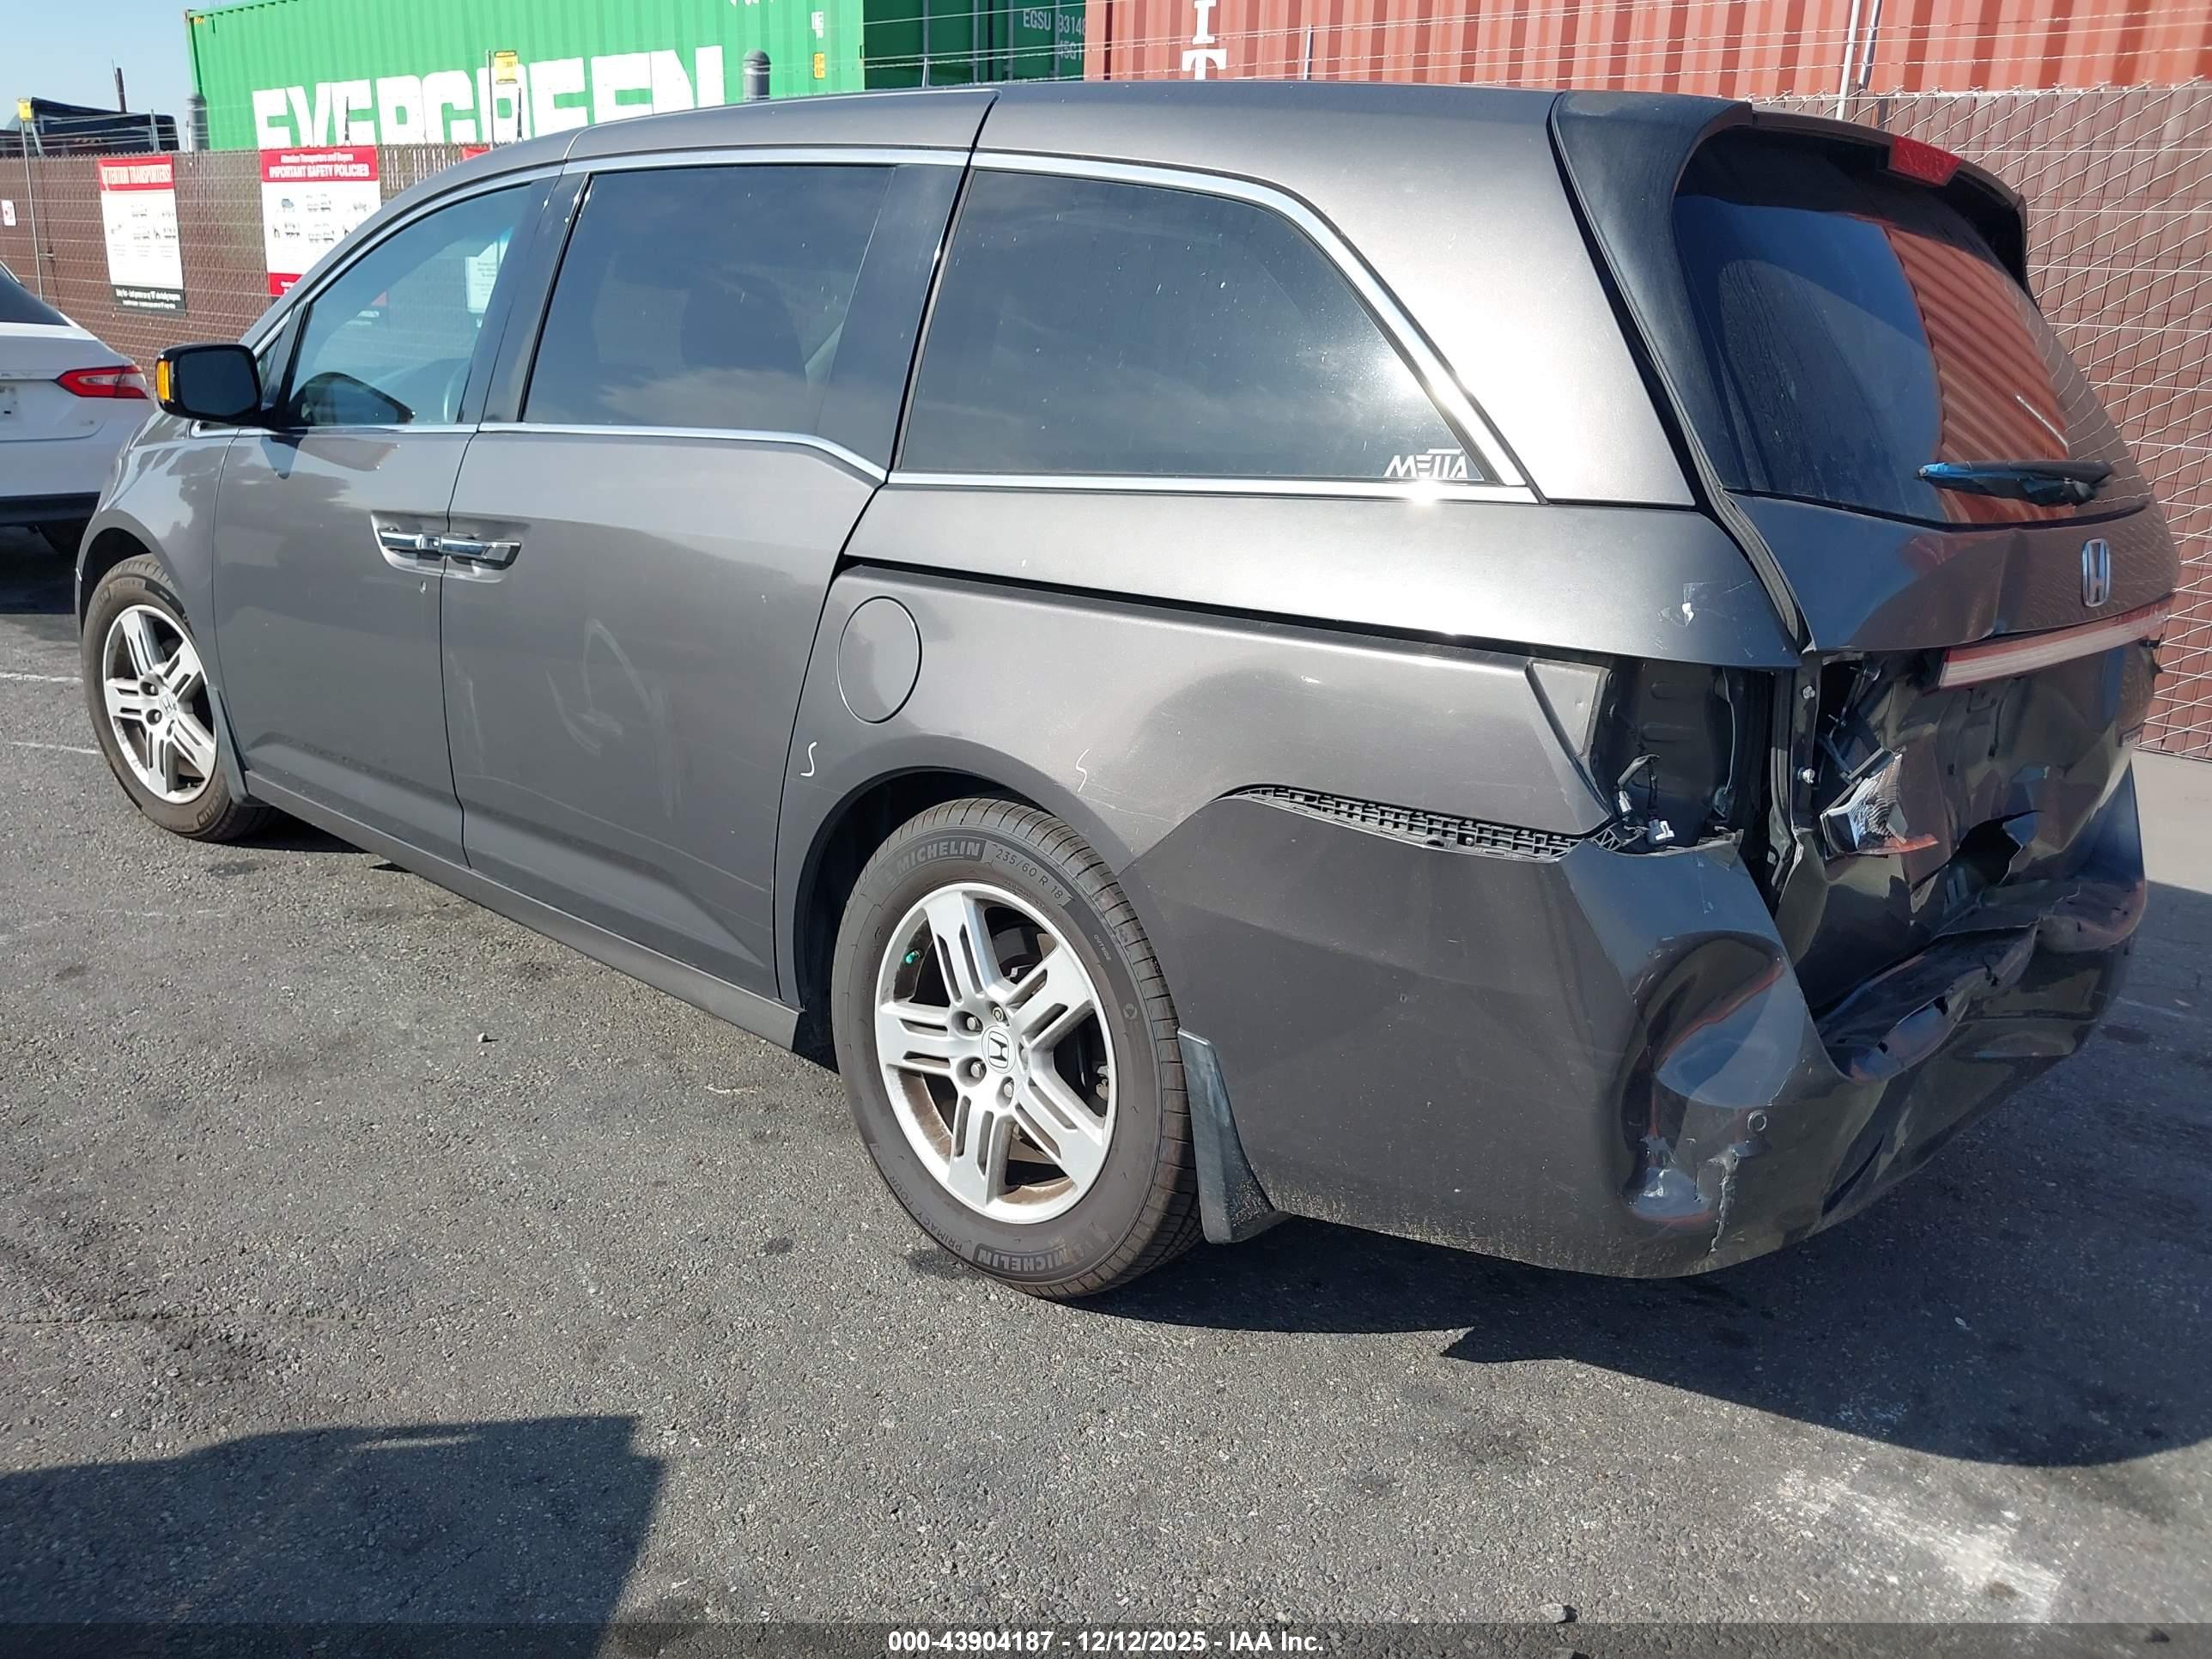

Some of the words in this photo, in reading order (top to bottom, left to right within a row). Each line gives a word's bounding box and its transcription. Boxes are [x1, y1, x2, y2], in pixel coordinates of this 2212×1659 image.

[1023, 9, 1051, 31] EGSU
[252, 45, 725, 149] EVERGREEN
[269, 166, 307, 179] IMPORTANT
[307, 164, 333, 178] SAFETY
[334, 163, 370, 177] POLICIES
[896, 841, 981, 873] MICHELIN
[995, 848, 1037, 878] 235/60
[1038, 875, 1049, 887] R
[1050, 885, 1064, 900] 18
[977, 1247, 1067, 1272] MICHELIN
